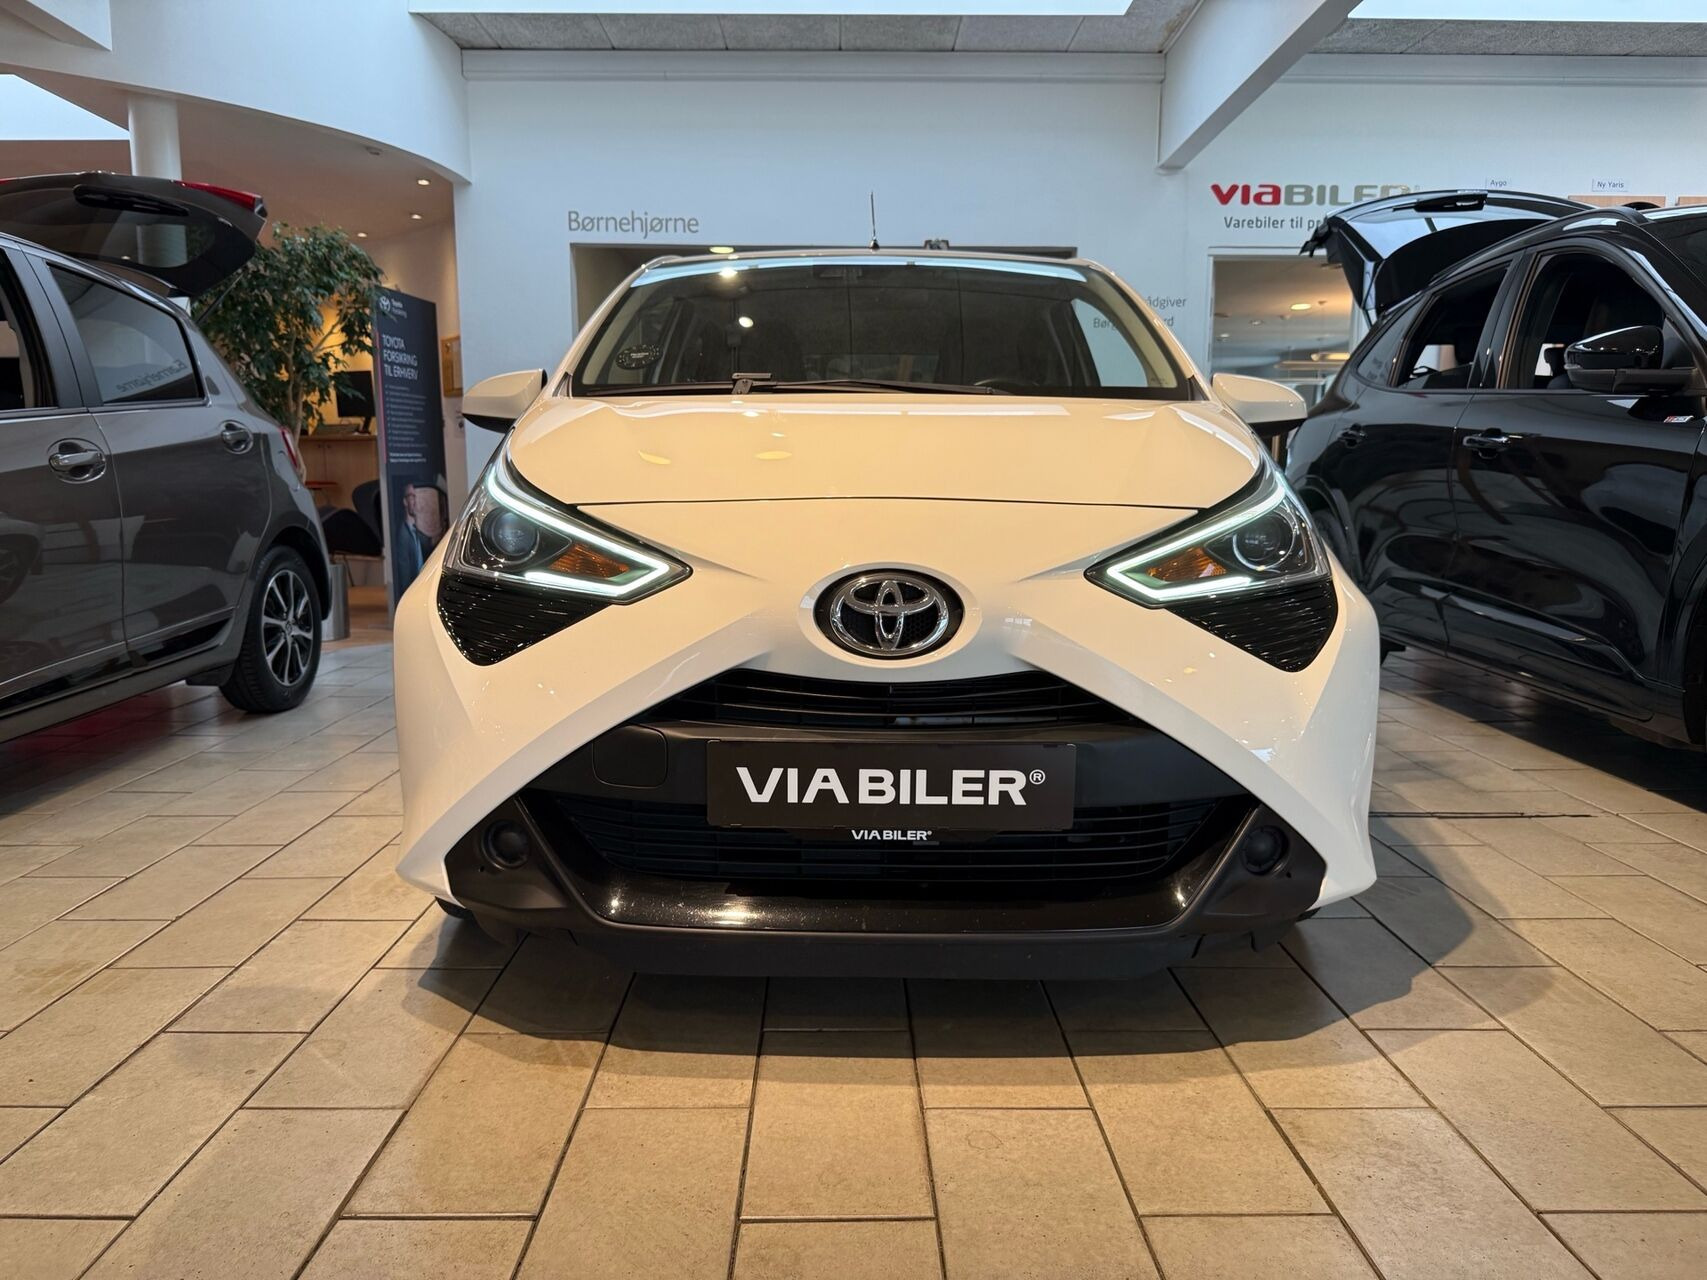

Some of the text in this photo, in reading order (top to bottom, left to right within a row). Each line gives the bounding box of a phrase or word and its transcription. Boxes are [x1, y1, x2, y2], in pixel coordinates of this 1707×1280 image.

[1490, 179, 1507, 188] Aygo
[1597, 181, 1606, 189] Ny
[568, 210, 699, 239] Børnehjørne
[1224, 216, 1285, 229] Varebiler
[1290, 216, 1303, 229] til
[1146, 296, 1187, 310] ådgiver
[382, 333, 406, 351] TOYOTA
[383, 349, 418, 367] FORSIKRING
[384, 363, 393, 377] TIL
[736, 767, 850, 804] VIA
[851, 829, 881, 840] VIA
